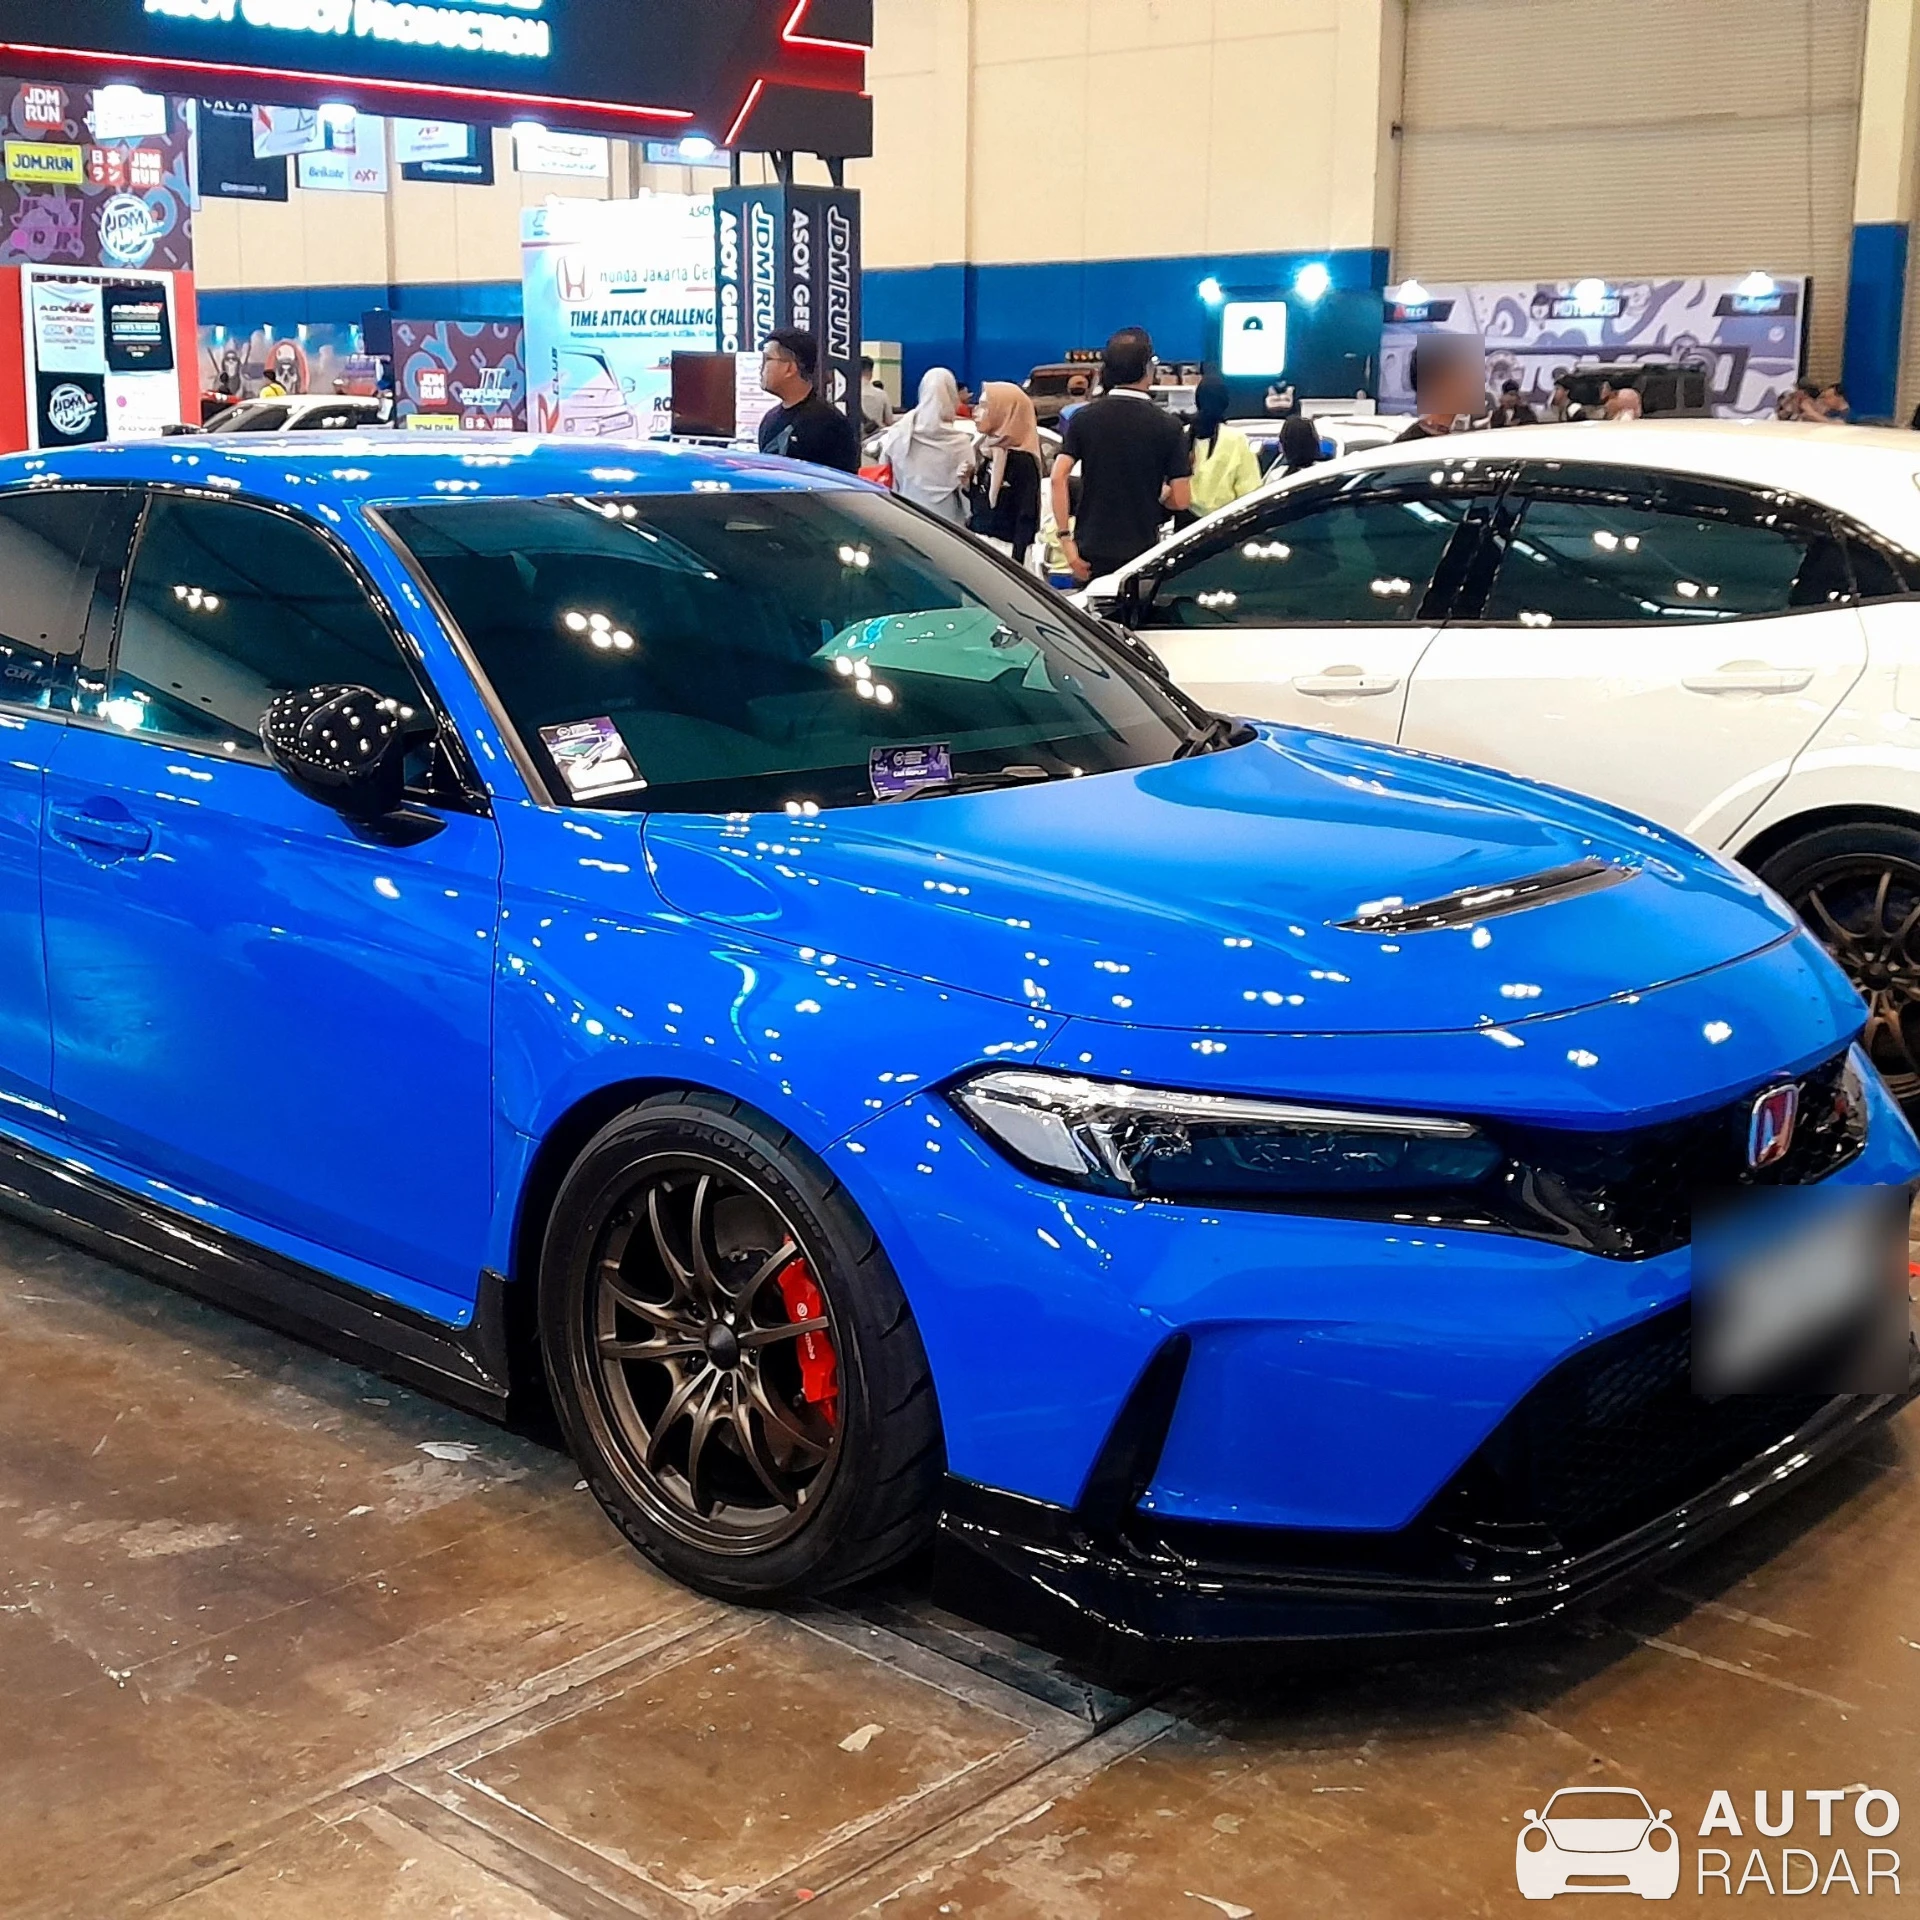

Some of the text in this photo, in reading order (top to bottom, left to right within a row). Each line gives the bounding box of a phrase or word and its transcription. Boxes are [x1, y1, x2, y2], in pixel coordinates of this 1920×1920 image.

[25, 88, 60, 106] JDM
[25, 104, 61, 122] RUN
[131, 152, 162, 169] JDM
[130, 167, 161, 185] RUN
[720, 210, 738, 280] ASOY
[792, 208, 810, 280] ASOY
[570, 310, 598, 327] TIME
[600, 309, 647, 326] ATTACK
[420, 385, 446, 399] RUN
[677, 1124, 784, 1185] PROXES
